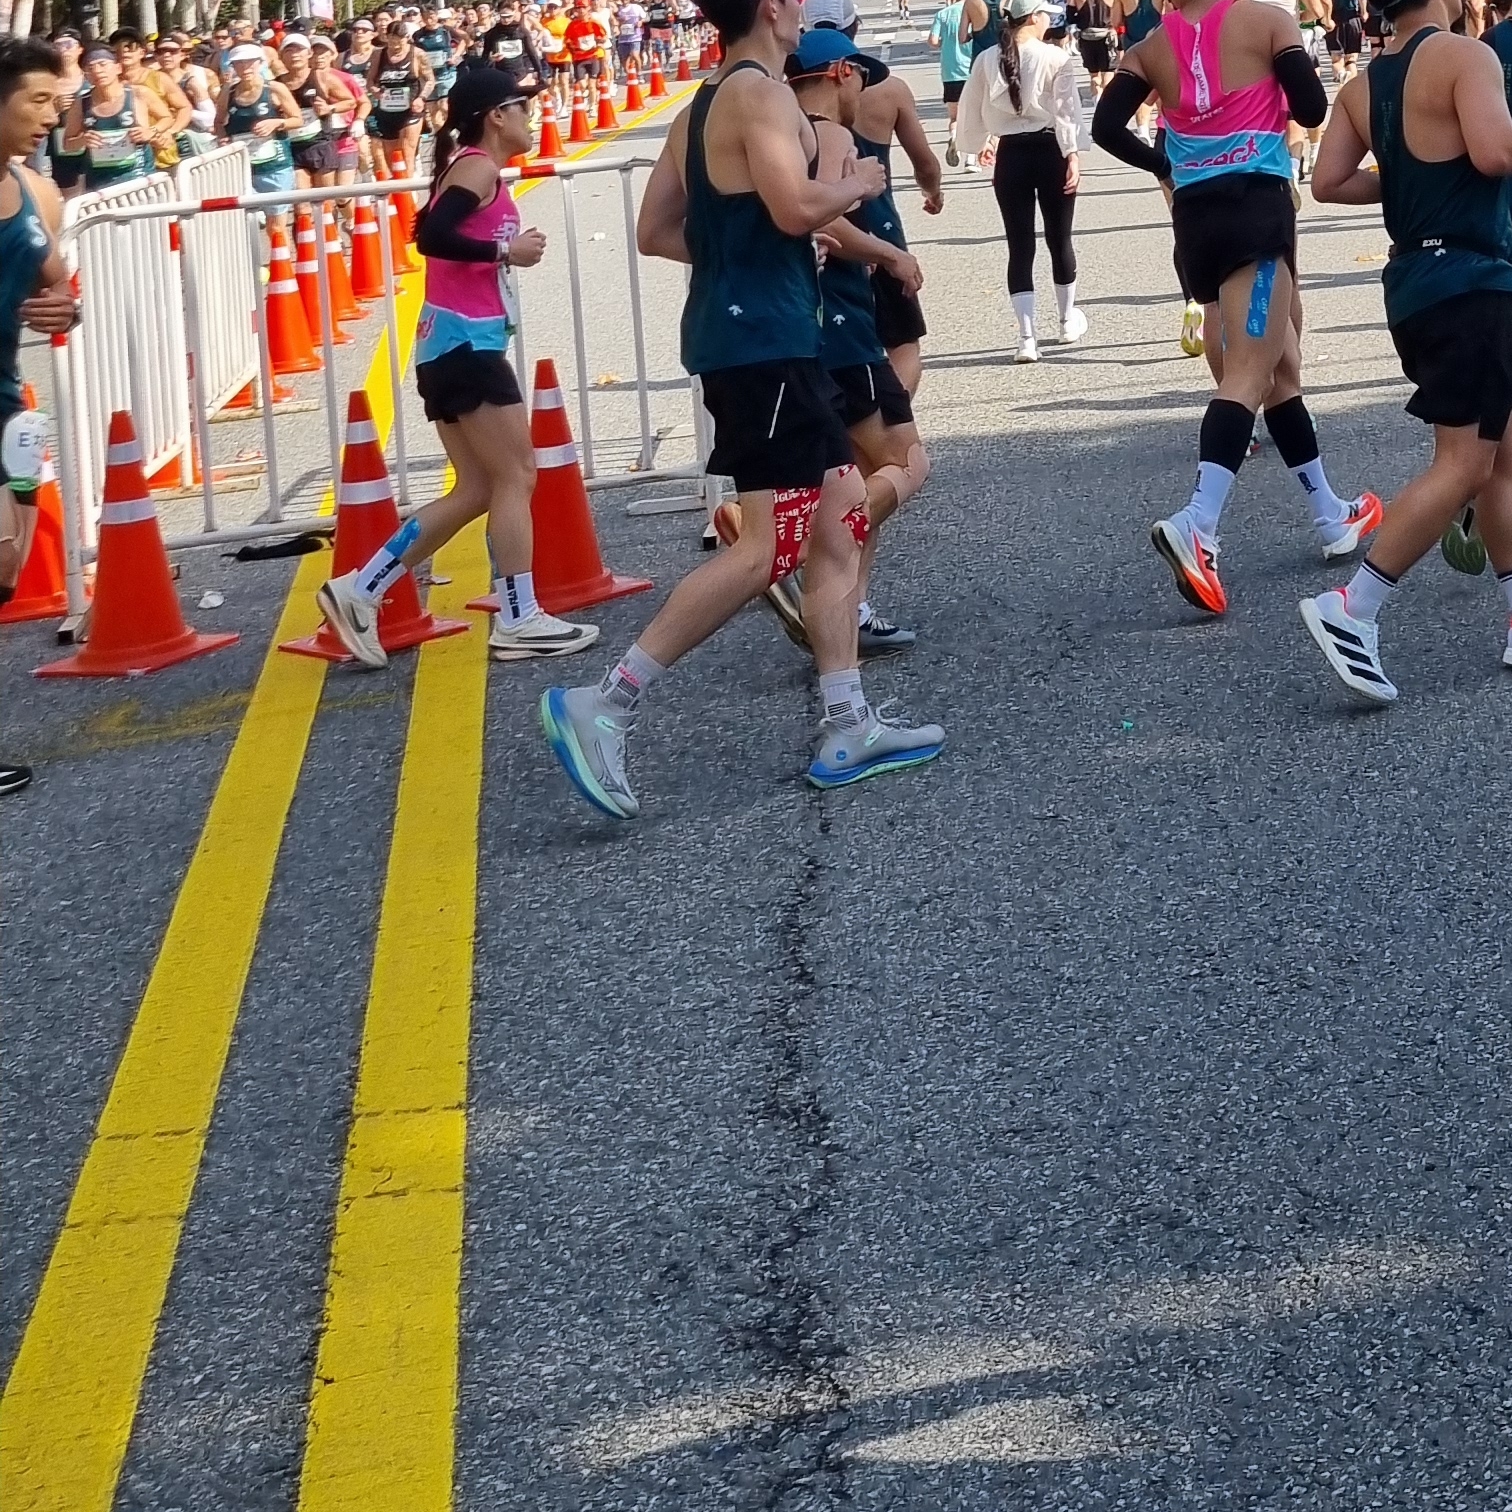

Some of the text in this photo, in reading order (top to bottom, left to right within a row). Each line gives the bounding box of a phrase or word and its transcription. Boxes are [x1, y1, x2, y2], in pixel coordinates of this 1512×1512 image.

[121, 111, 134, 126] S
[1422, 238, 1442, 247] 2XU
[18, 431, 30, 447] E
